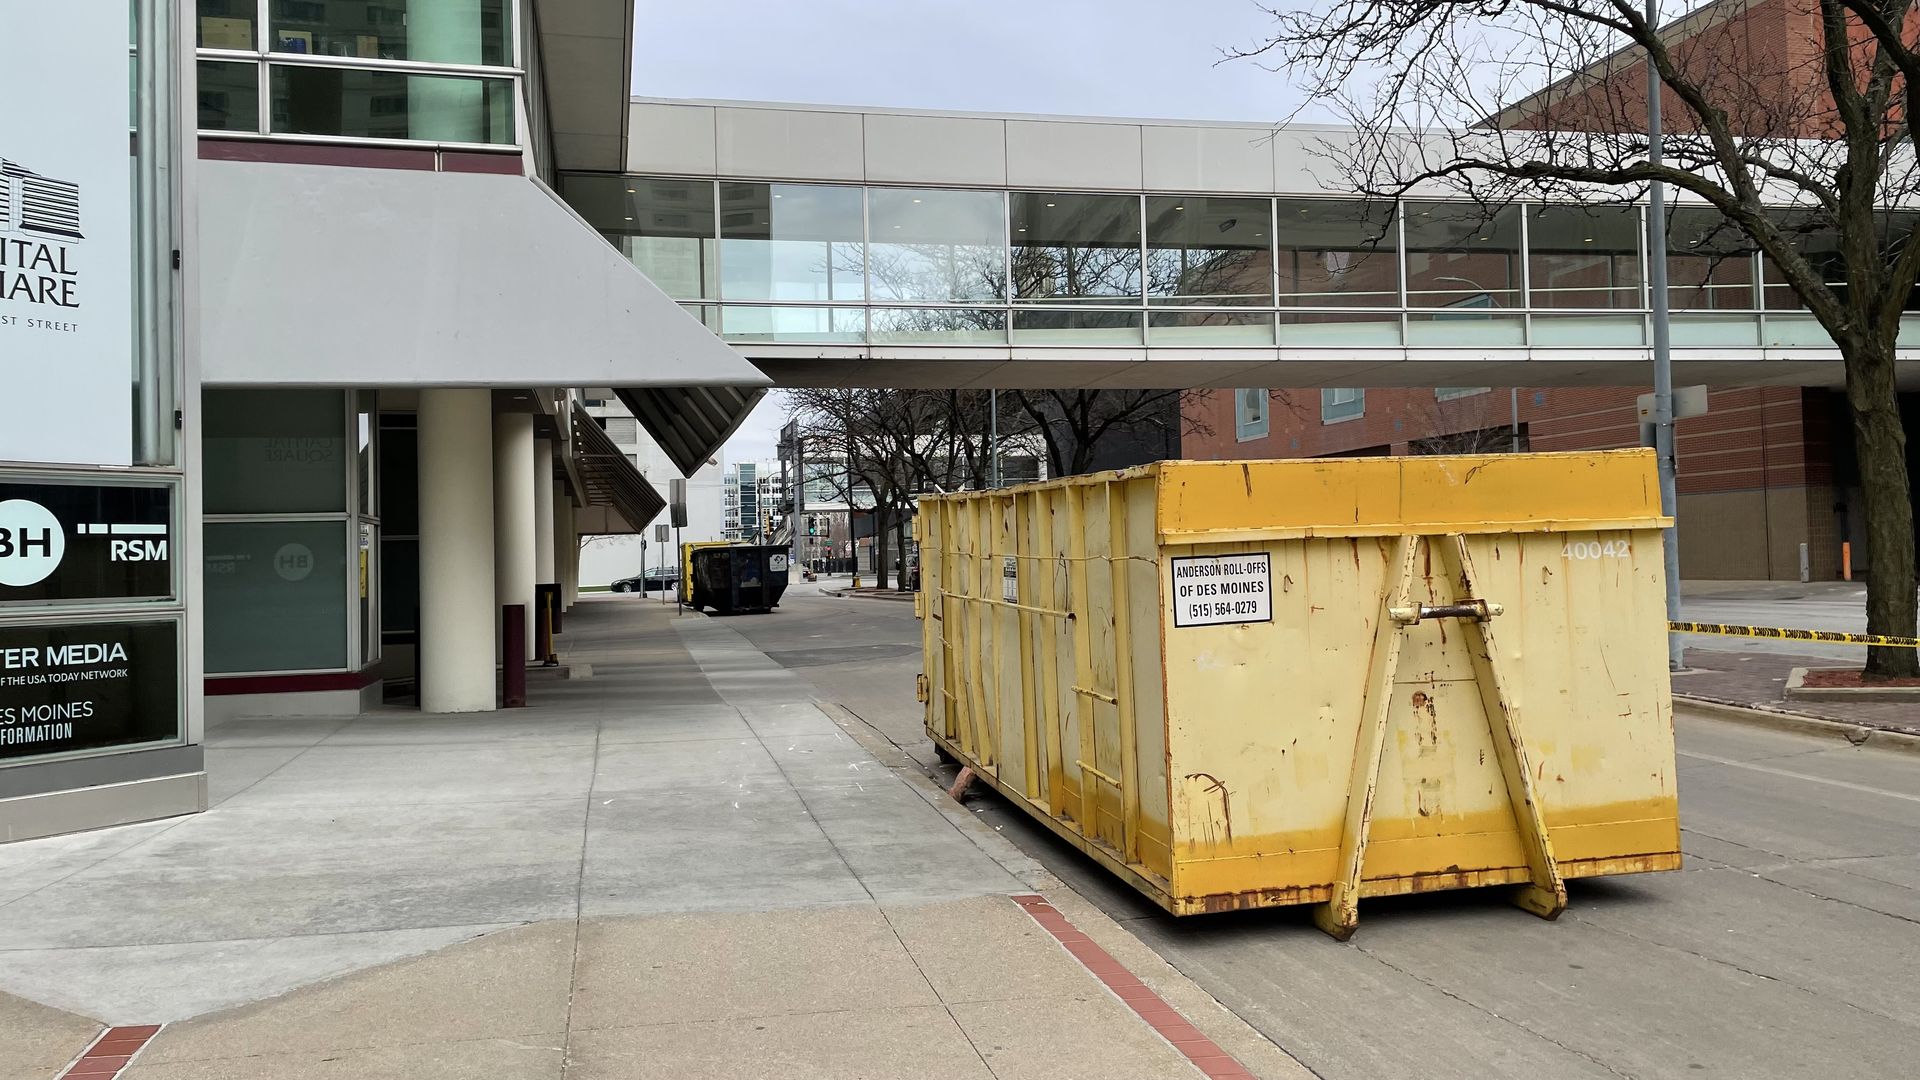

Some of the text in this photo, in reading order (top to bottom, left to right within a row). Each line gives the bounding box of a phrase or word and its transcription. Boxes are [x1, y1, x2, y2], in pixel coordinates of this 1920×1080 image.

[27, 318, 78, 332] STREET
[111, 540, 167, 561] RSM
[1561, 540, 1629, 560] 40042
[1176, 562, 1266, 578] ANDERSON ROLL-OFFS
[1180, 581, 1264, 597] OF DES MOINES
[1189, 600, 1257, 619] (515) 564-0279
[46, 642, 128, 666] MEDIA
[7, 675, 26, 686] THE
[27, 674, 47, 685] USA
[48, 672, 80, 683] TODAY
[80, 668, 128, 681] NETWORK
[21, 701, 94, 723] MOINES
[0, 722, 72, 746] FORMATION
